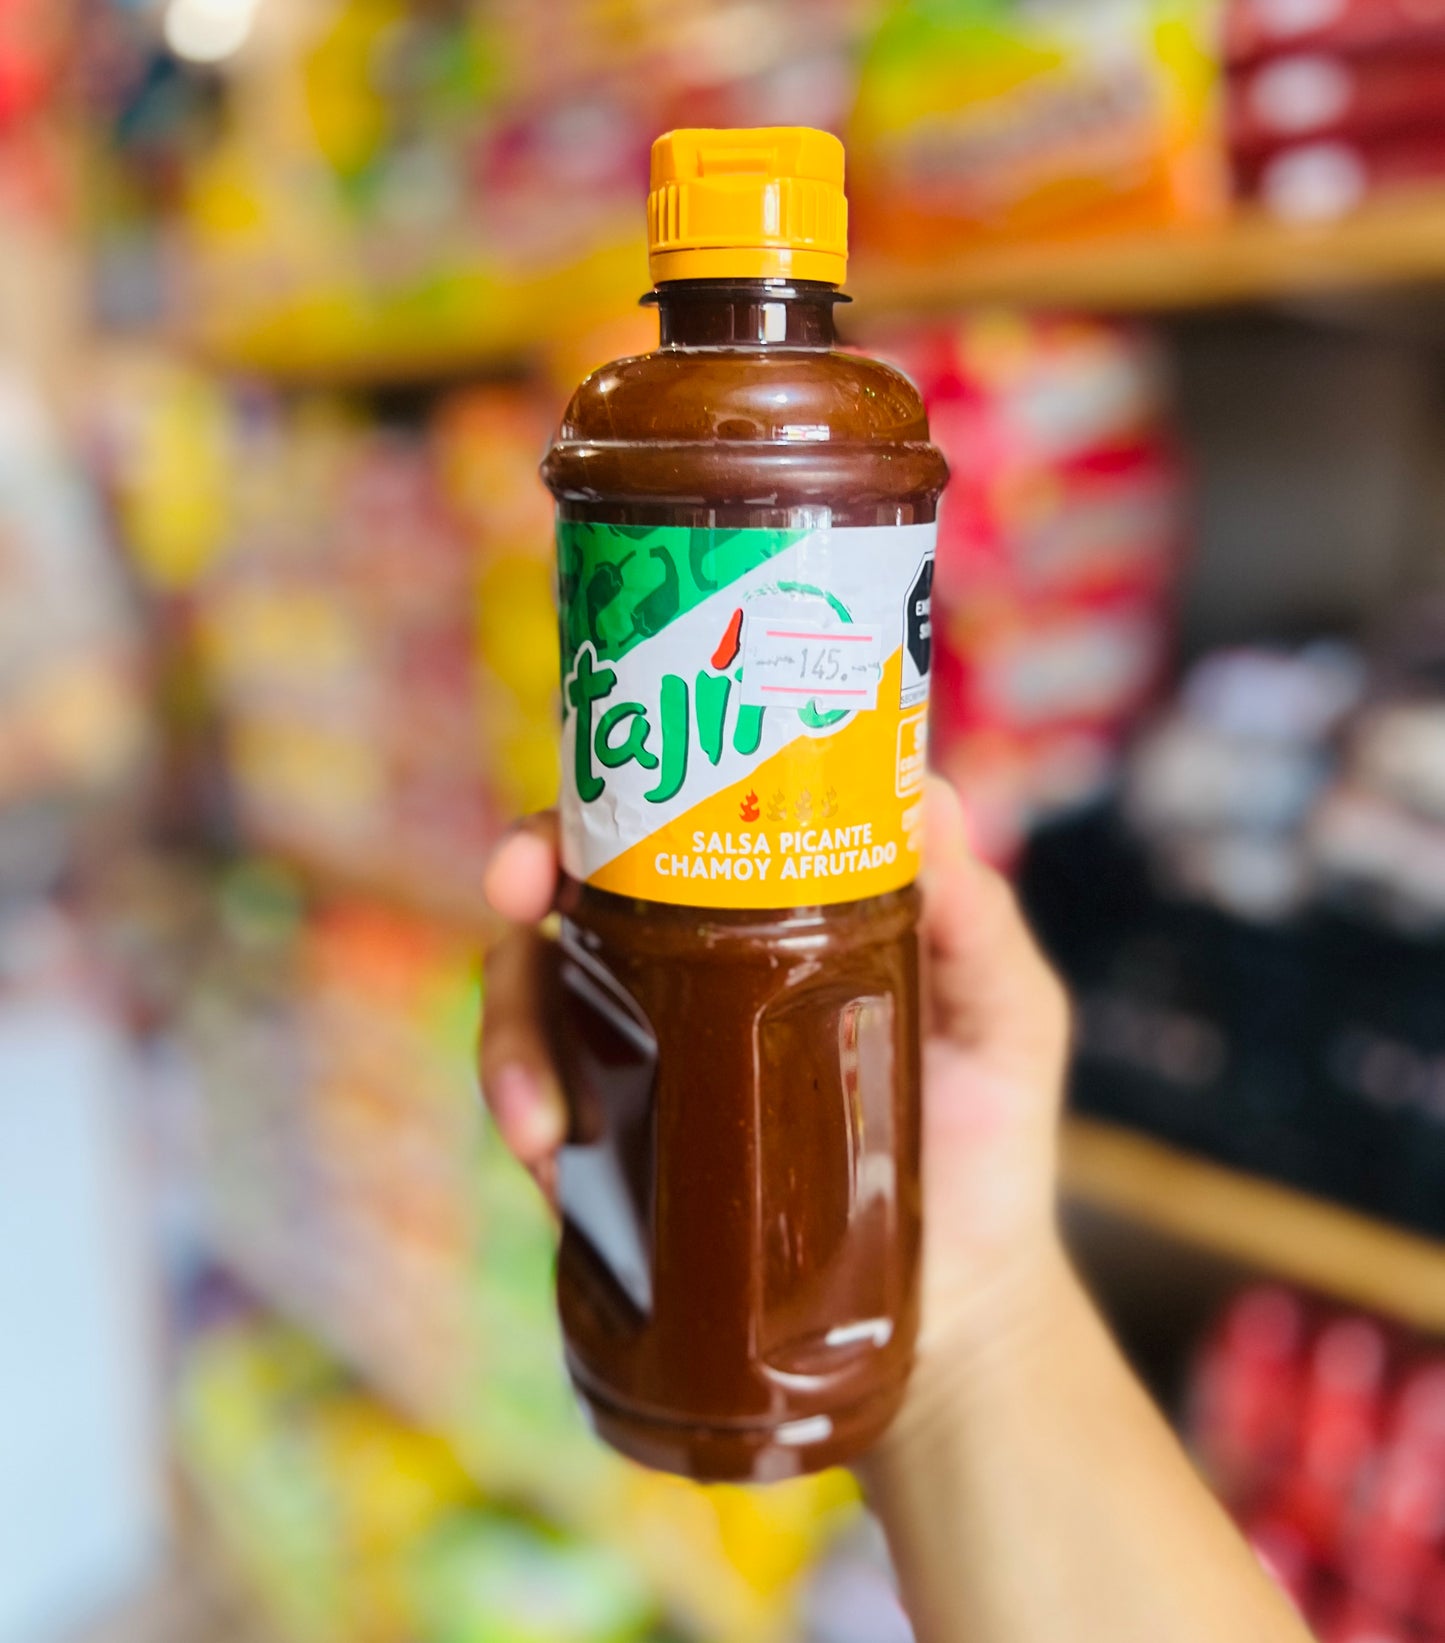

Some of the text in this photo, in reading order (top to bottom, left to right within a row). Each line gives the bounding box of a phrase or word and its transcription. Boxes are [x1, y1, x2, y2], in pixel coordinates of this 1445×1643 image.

[692, 823, 872, 854] SALSA PICANTE
[655, 852, 771, 880] CHAMOY
[780, 841, 897, 880] AFRUTADO
